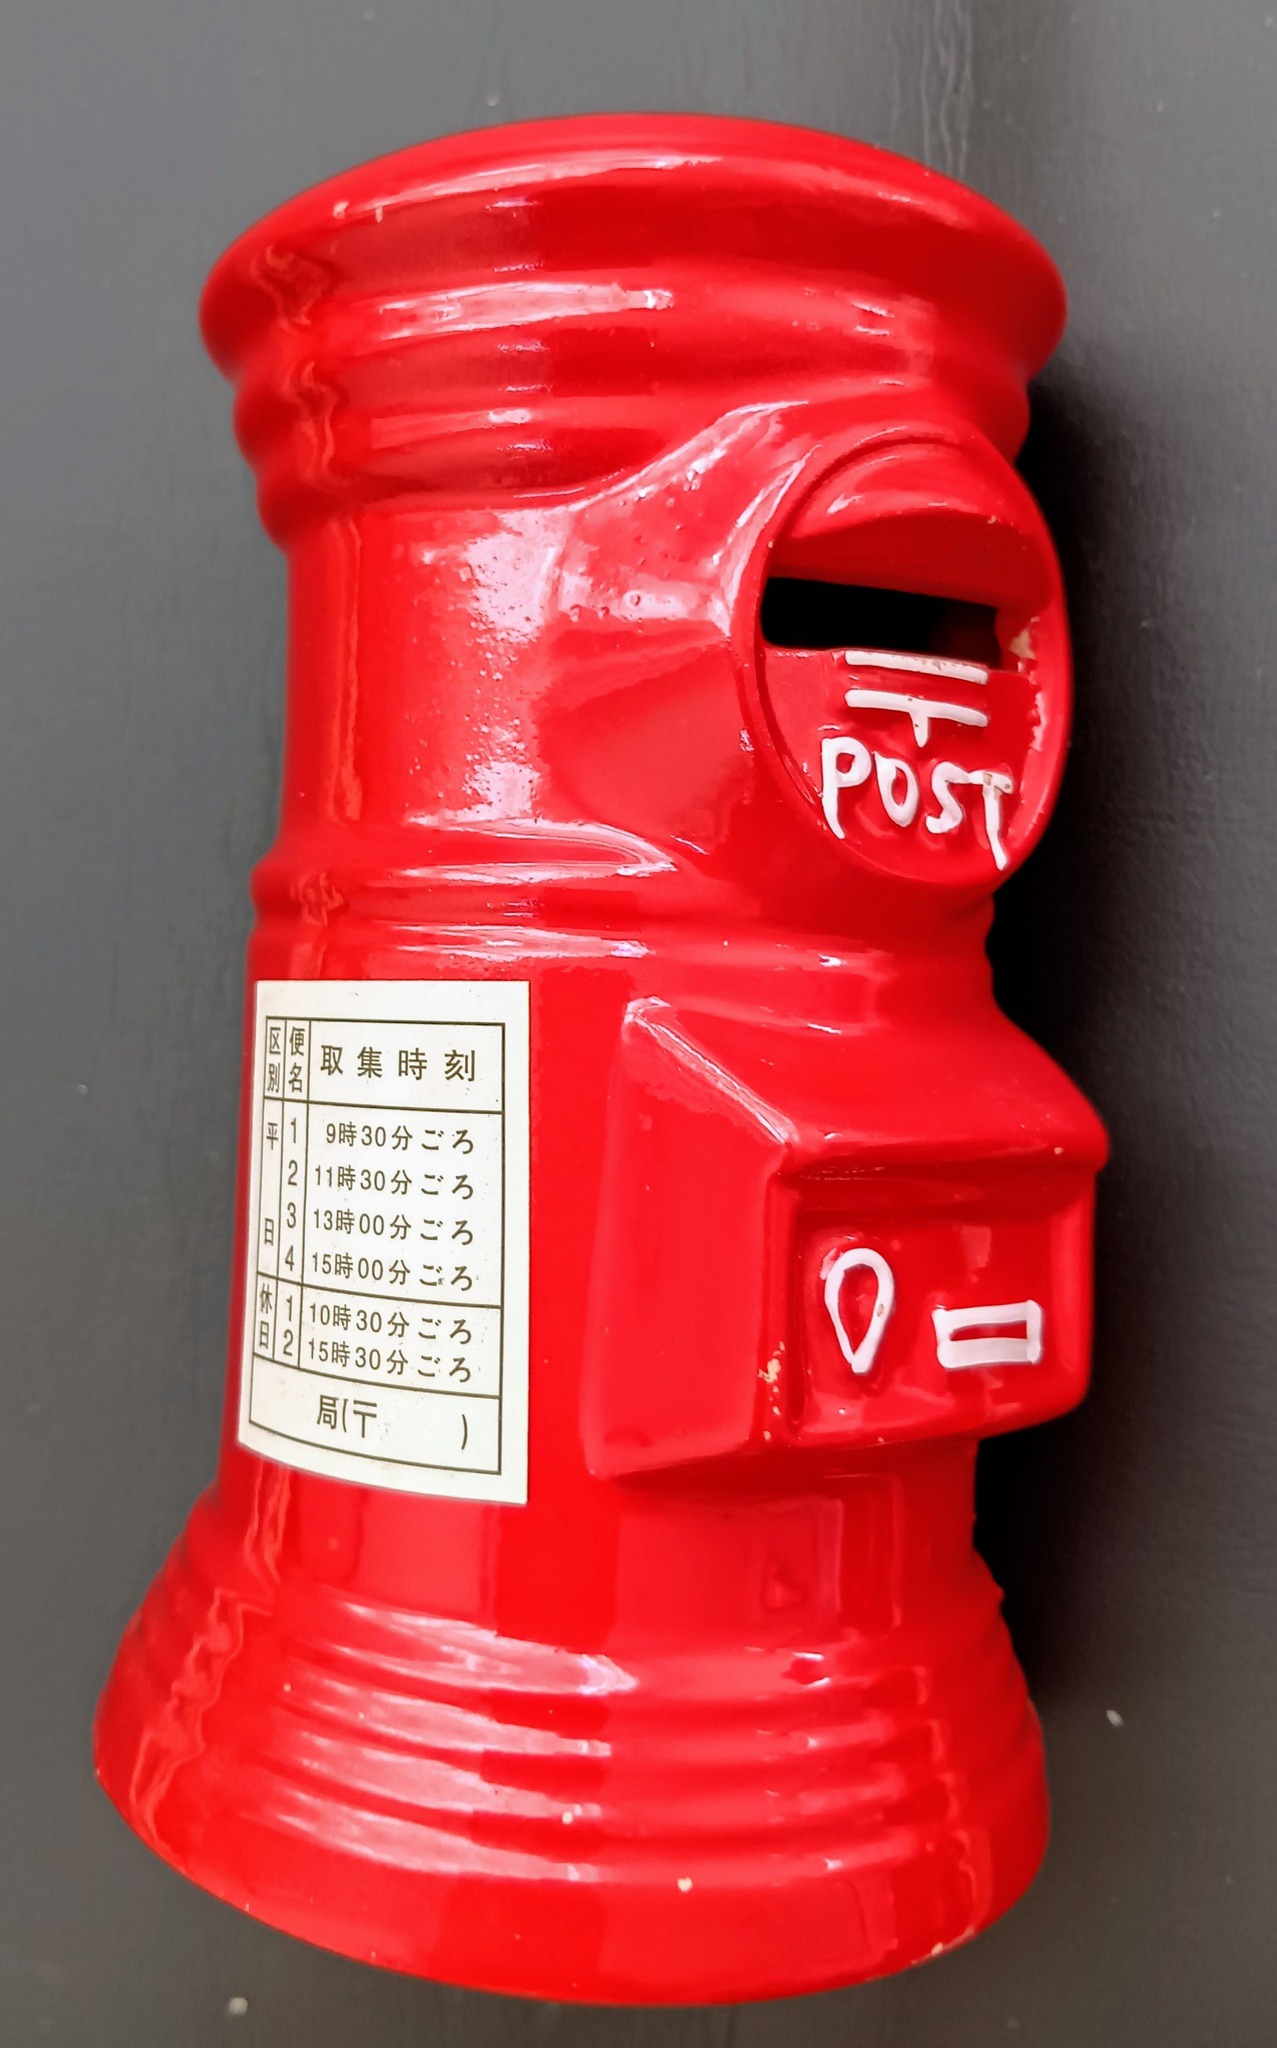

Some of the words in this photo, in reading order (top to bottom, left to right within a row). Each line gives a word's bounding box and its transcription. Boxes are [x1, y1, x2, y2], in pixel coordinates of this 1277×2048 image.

[821, 736, 1014, 871] POST
[266, 1026, 282, 1094] 区別
[288, 1026, 305, 1093] 便名
[320, 1045, 476, 1082] 取集時刻
[289, 1117, 298, 1144] 1
[325, 1121, 475, 1155] 9時30分ごろ
[287, 1159, 299, 1187] 2
[314, 1164, 475, 1200] 11時30分ごろ
[286, 1202, 297, 1229] 3
[313, 1208, 474, 1246] 13時00分ごろ
[284, 1245, 295, 1273] 4
[311, 1251, 473, 1292] 15時00分ごろ
[258, 1283, 273, 1350] 休日
[285, 1295, 293, 1323] 1
[309, 1302, 472, 1345] 10時30分ごろ
[282, 1328, 294, 1357] 2
[307, 1337, 472, 1383] 15時30分ごろ
